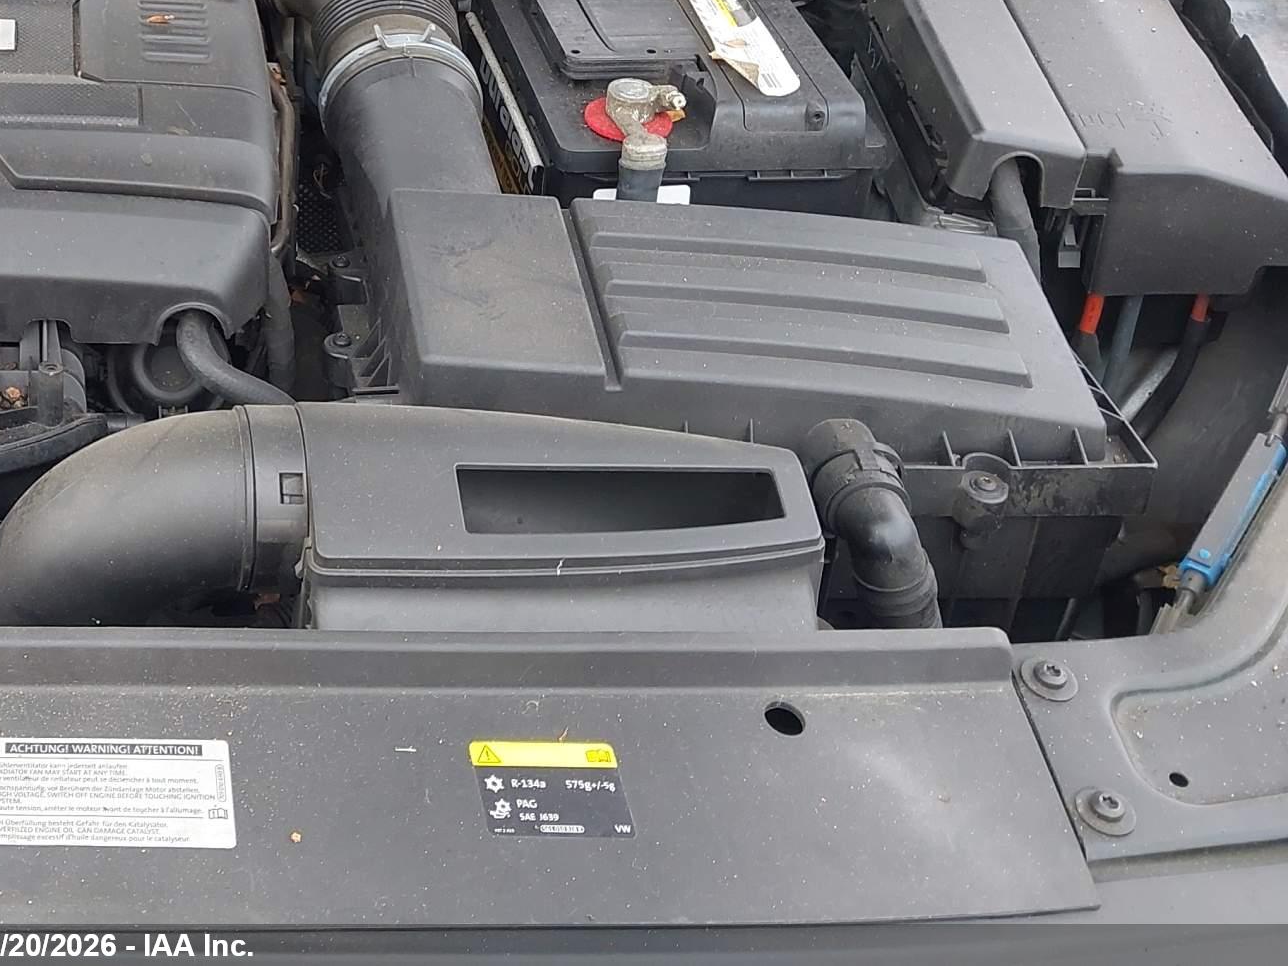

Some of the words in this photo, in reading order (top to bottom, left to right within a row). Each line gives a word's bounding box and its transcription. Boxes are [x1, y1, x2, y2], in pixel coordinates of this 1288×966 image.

[9, 744, 69, 754] ACHTUNG!
[72, 744, 130, 754] WARNING!
[133, 745, 199, 755] ATTENTION!
[510, 778, 547, 789] R-134a
[516, 799, 538, 809] PAG
[519, 813, 537, 821] SAE
[614, 824, 632, 834] VW
